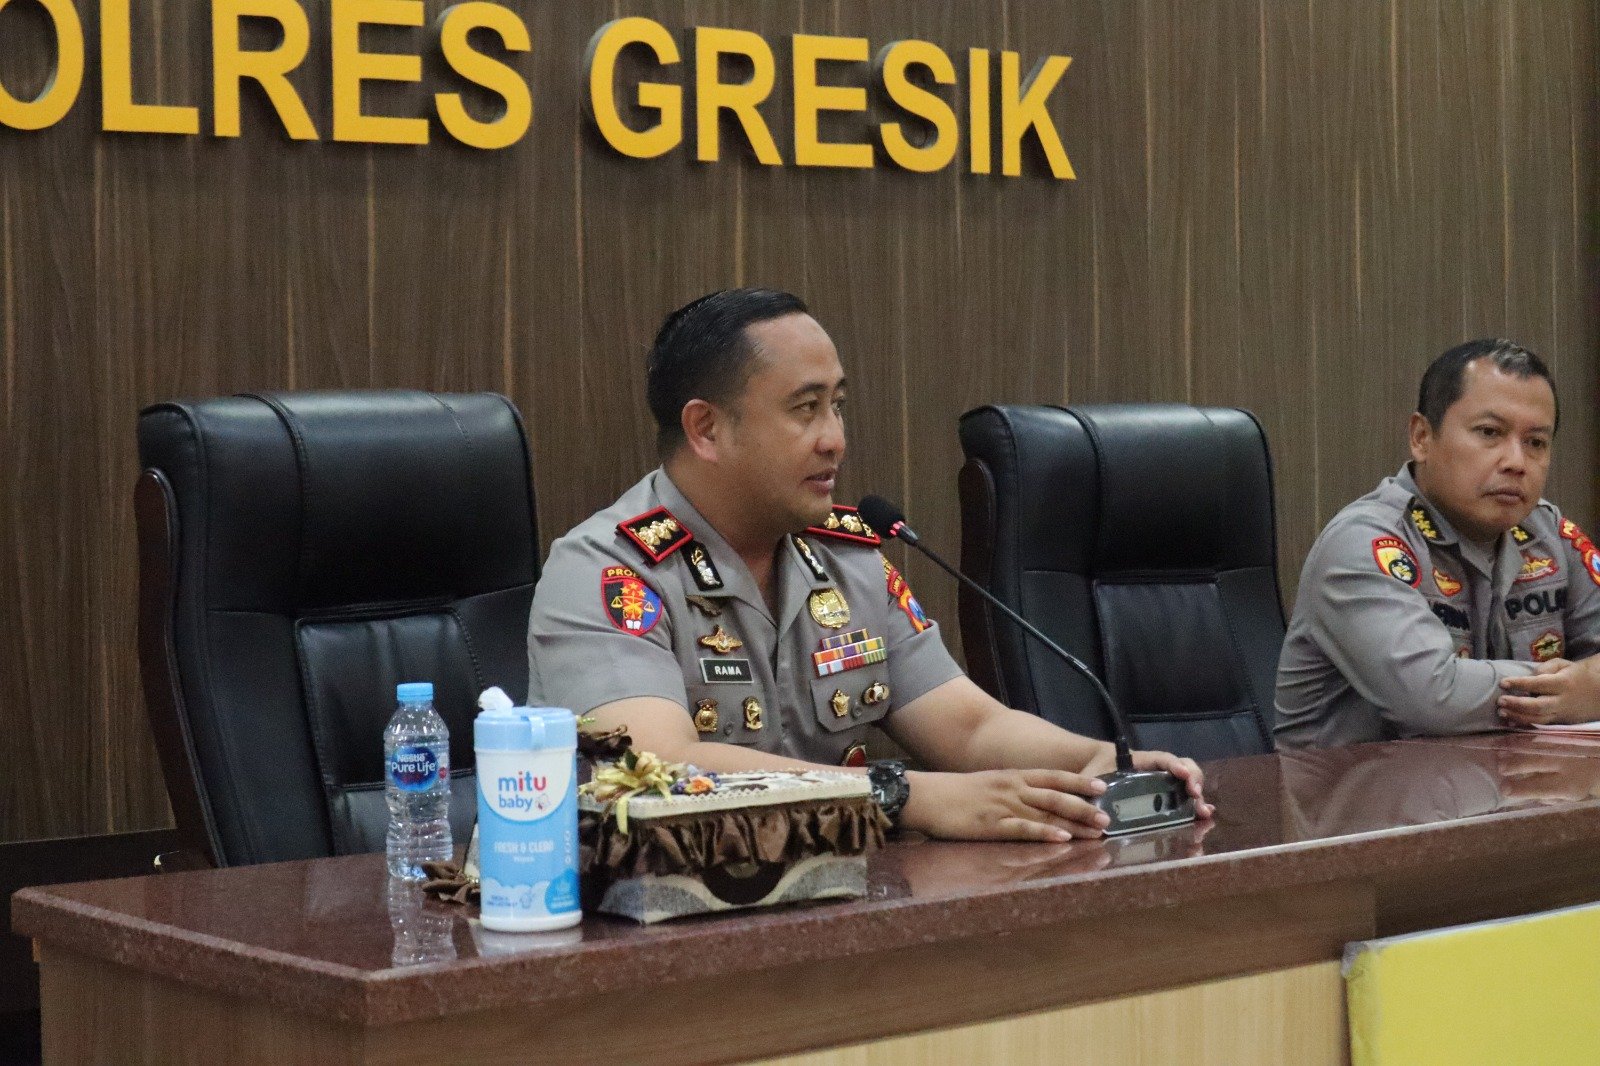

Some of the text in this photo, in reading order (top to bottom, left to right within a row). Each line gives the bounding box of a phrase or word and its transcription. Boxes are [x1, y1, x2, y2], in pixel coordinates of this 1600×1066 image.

[586, 16, 1077, 180] GRESIK
[714, 665, 742, 676] RAMA
[391, 761, 436, 776] Pure Life
[498, 771, 547, 791] mitu
[499, 794, 533, 811] baby
